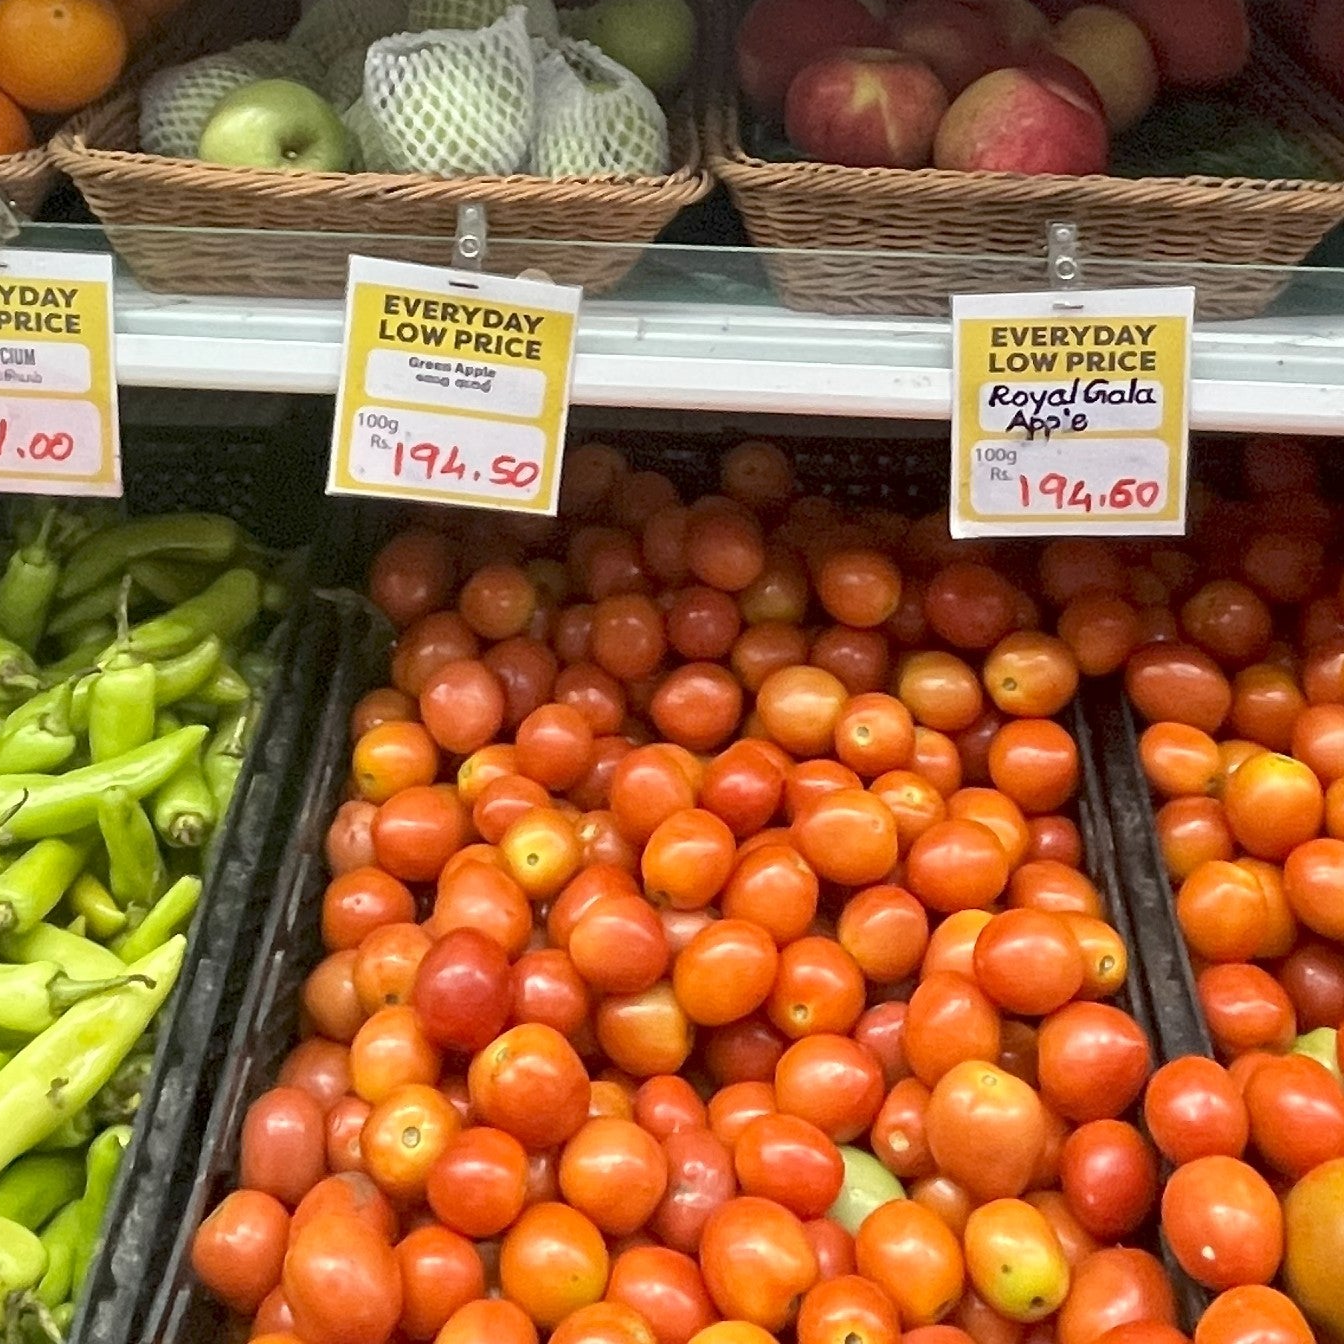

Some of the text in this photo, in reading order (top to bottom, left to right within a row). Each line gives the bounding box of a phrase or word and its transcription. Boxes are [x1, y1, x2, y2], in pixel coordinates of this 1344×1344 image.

[384, 294, 545, 334] EVERYDAY
[378, 319, 542, 360] LOW PRICE
[990, 324, 1158, 348] EVERYDAY
[409, 356, 496, 379] Green Apple
[988, 350, 1157, 373] LOW PRICE
[988, 377, 1157, 415] Royal Gala
[358, 412, 399, 434] 100g
[1005, 408, 1088, 442] Appe
[393, 442, 540, 488] 194.50
[975, 447, 1017, 465] 100g
